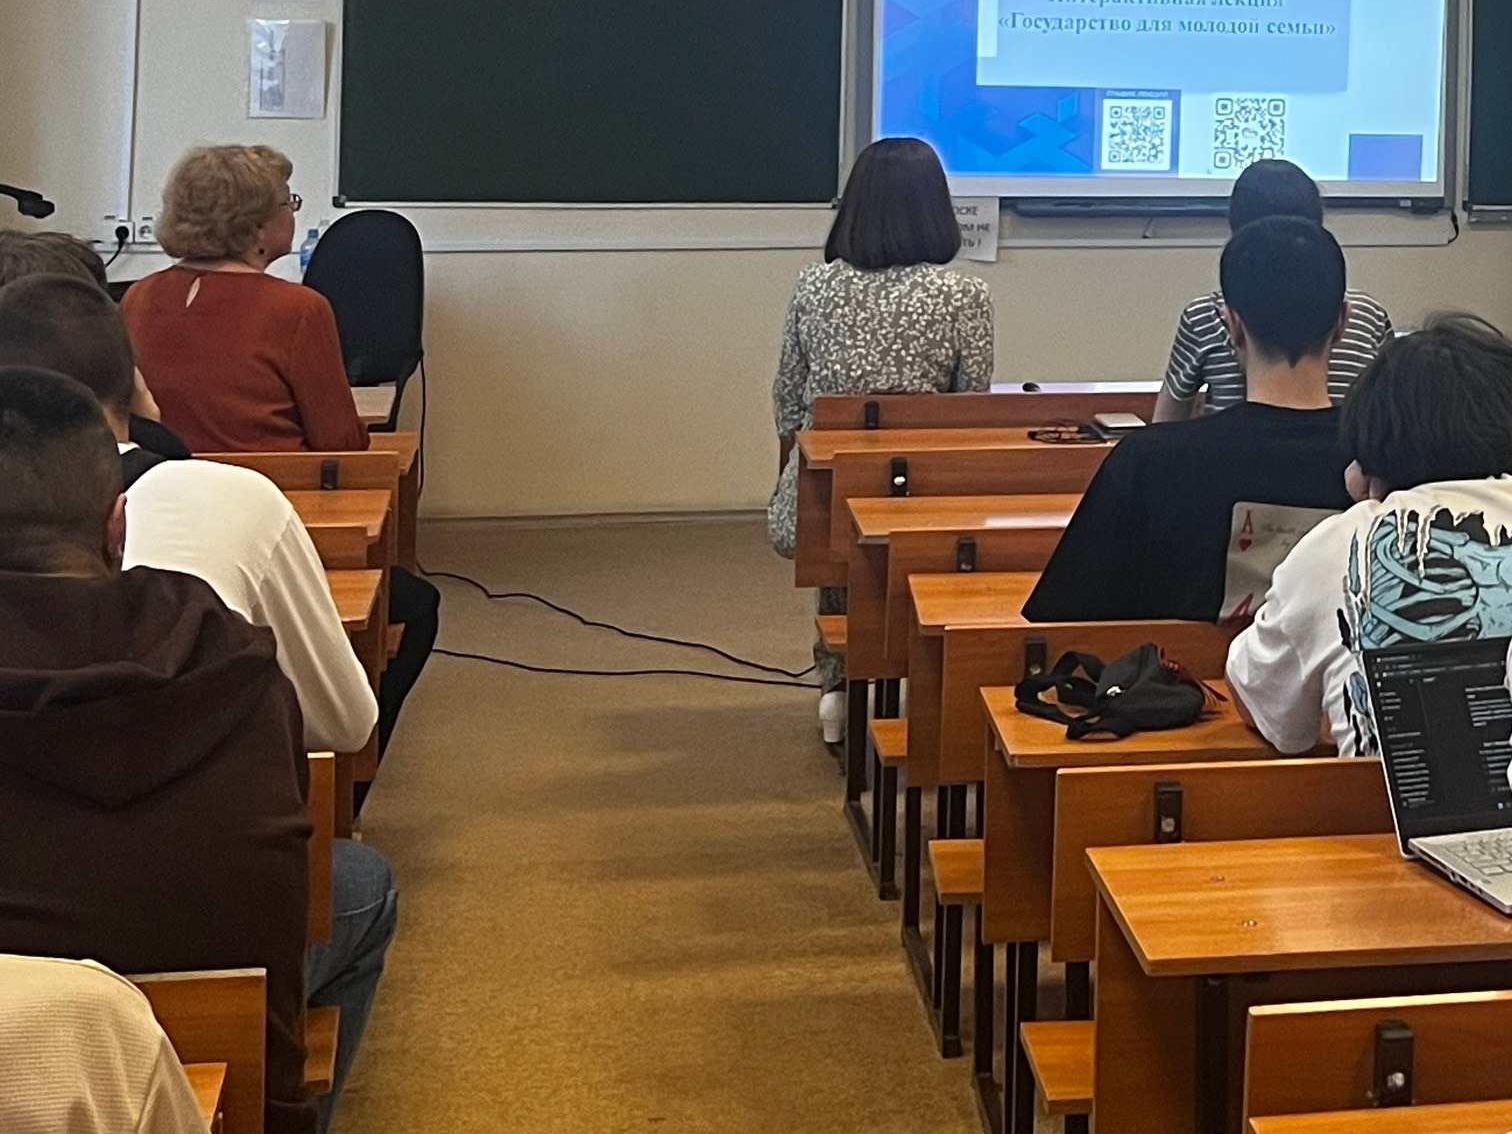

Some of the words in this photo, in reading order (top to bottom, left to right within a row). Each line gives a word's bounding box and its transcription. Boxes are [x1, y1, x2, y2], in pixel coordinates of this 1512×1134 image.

[998, 12, 1132, 34] «Государство
[1136, 19, 1172, 34] для
[1178, 17, 1260, 34] молодой
[1267, 20, 1336, 35] семьи»
